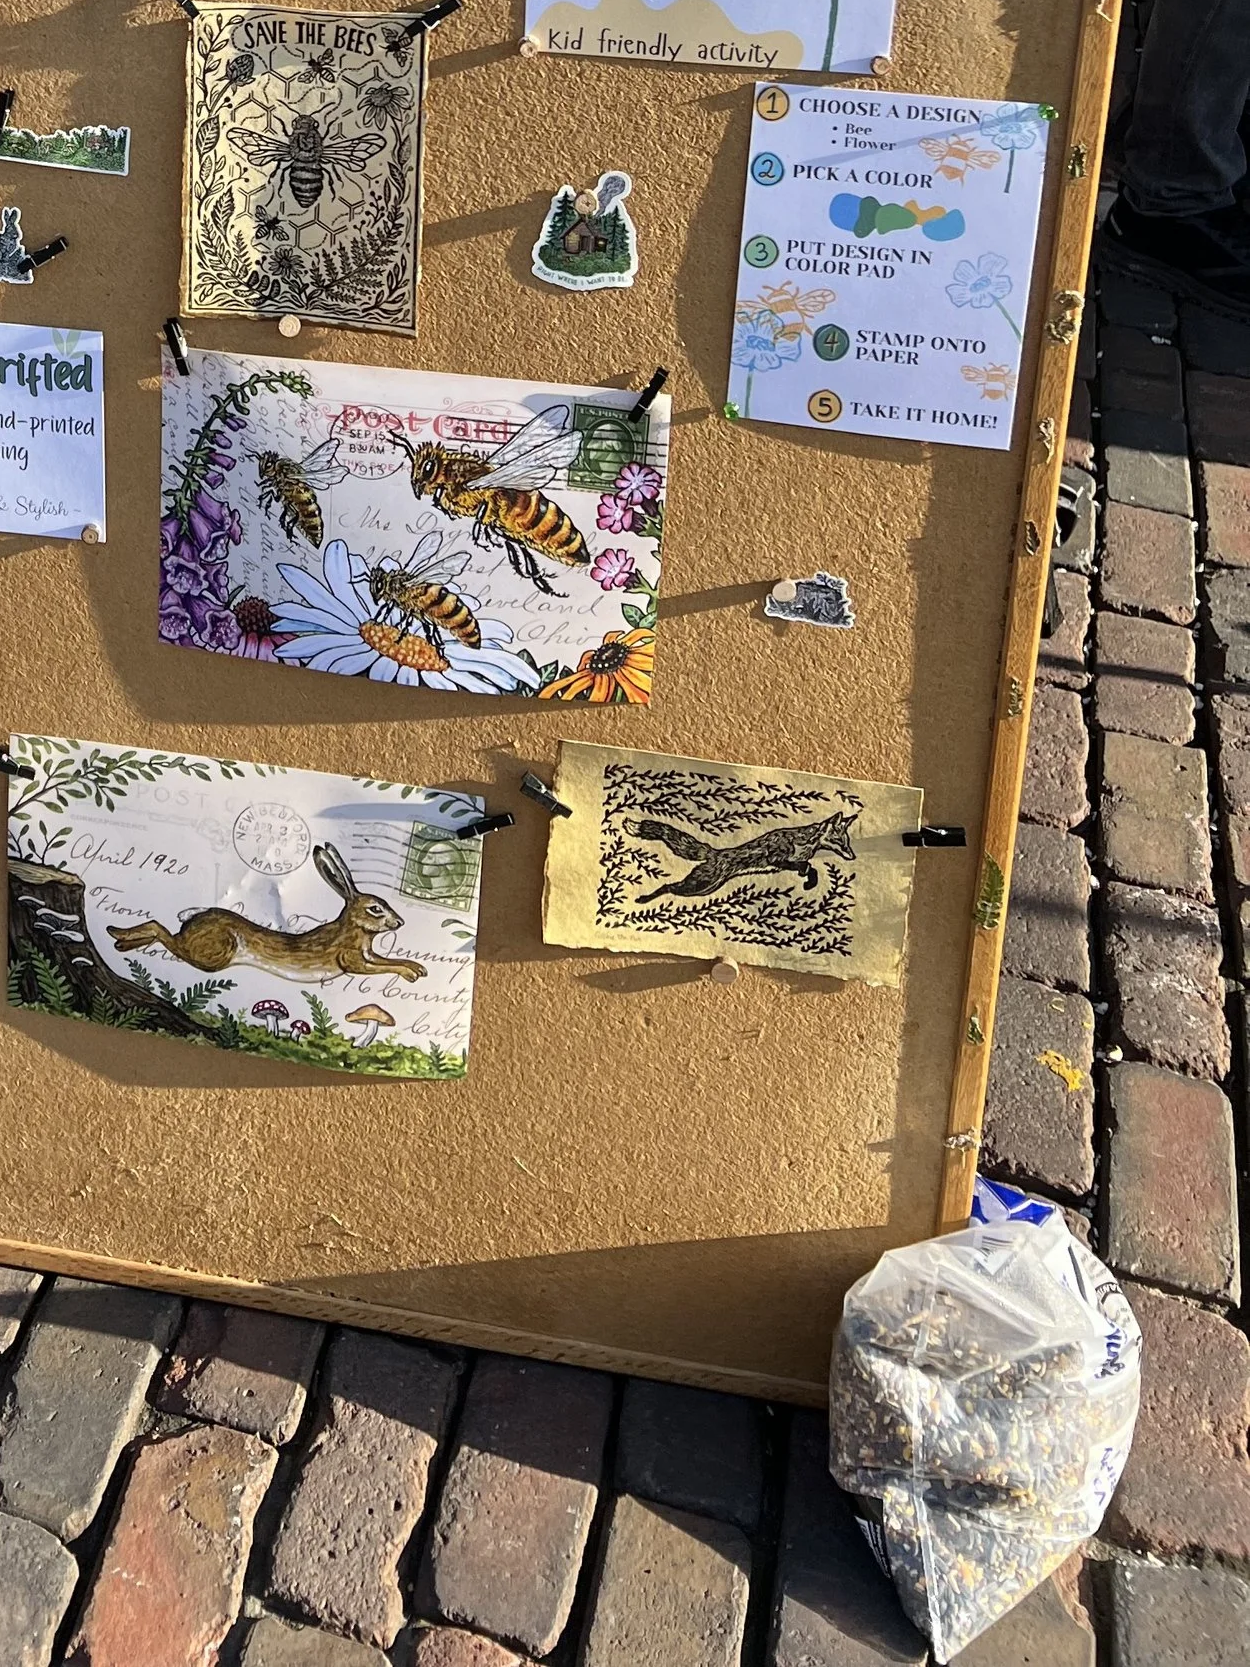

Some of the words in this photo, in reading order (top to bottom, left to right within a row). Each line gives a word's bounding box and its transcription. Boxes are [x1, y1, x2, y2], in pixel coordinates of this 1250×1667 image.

[243, 20, 287, 48] SAVE
[295, 21, 326, 47] THE
[333, 27, 378, 56] BEES
[548, 27, 583, 52] Kid
[596, 27, 683, 62] friendly
[696, 39, 780, 69] activity
[799, 97, 881, 119] CHOOSE
[887, 105, 902, 120] A
[906, 105, 983, 126] DESIGN
[845, 123, 873, 136] Bee
[843, 137, 898, 152] Flower
[792, 163, 840, 182] PICK
[848, 170, 864, 184] A
[866, 169, 933, 190] COLOR
[786, 239, 826, 257] PUT
[831, 243, 906, 264] DESIGN
[911, 249, 933, 265] IN
[785, 256, 850, 276] COLOR
[857, 262, 896, 280] PAD
[855, 328, 926, 349] STAMP
[931, 335, 987, 355] ONTO
[855, 347, 920, 367] PAPER
[850, 401, 901, 420] TAKE
[905, 407, 926, 423] IT
[931, 410, 999, 431] HOME!
[14, 495, 69, 525] Stylish
[70, 833, 135, 879] April
[139, 850, 190, 875] 1920
[90, 886, 155, 920] From
